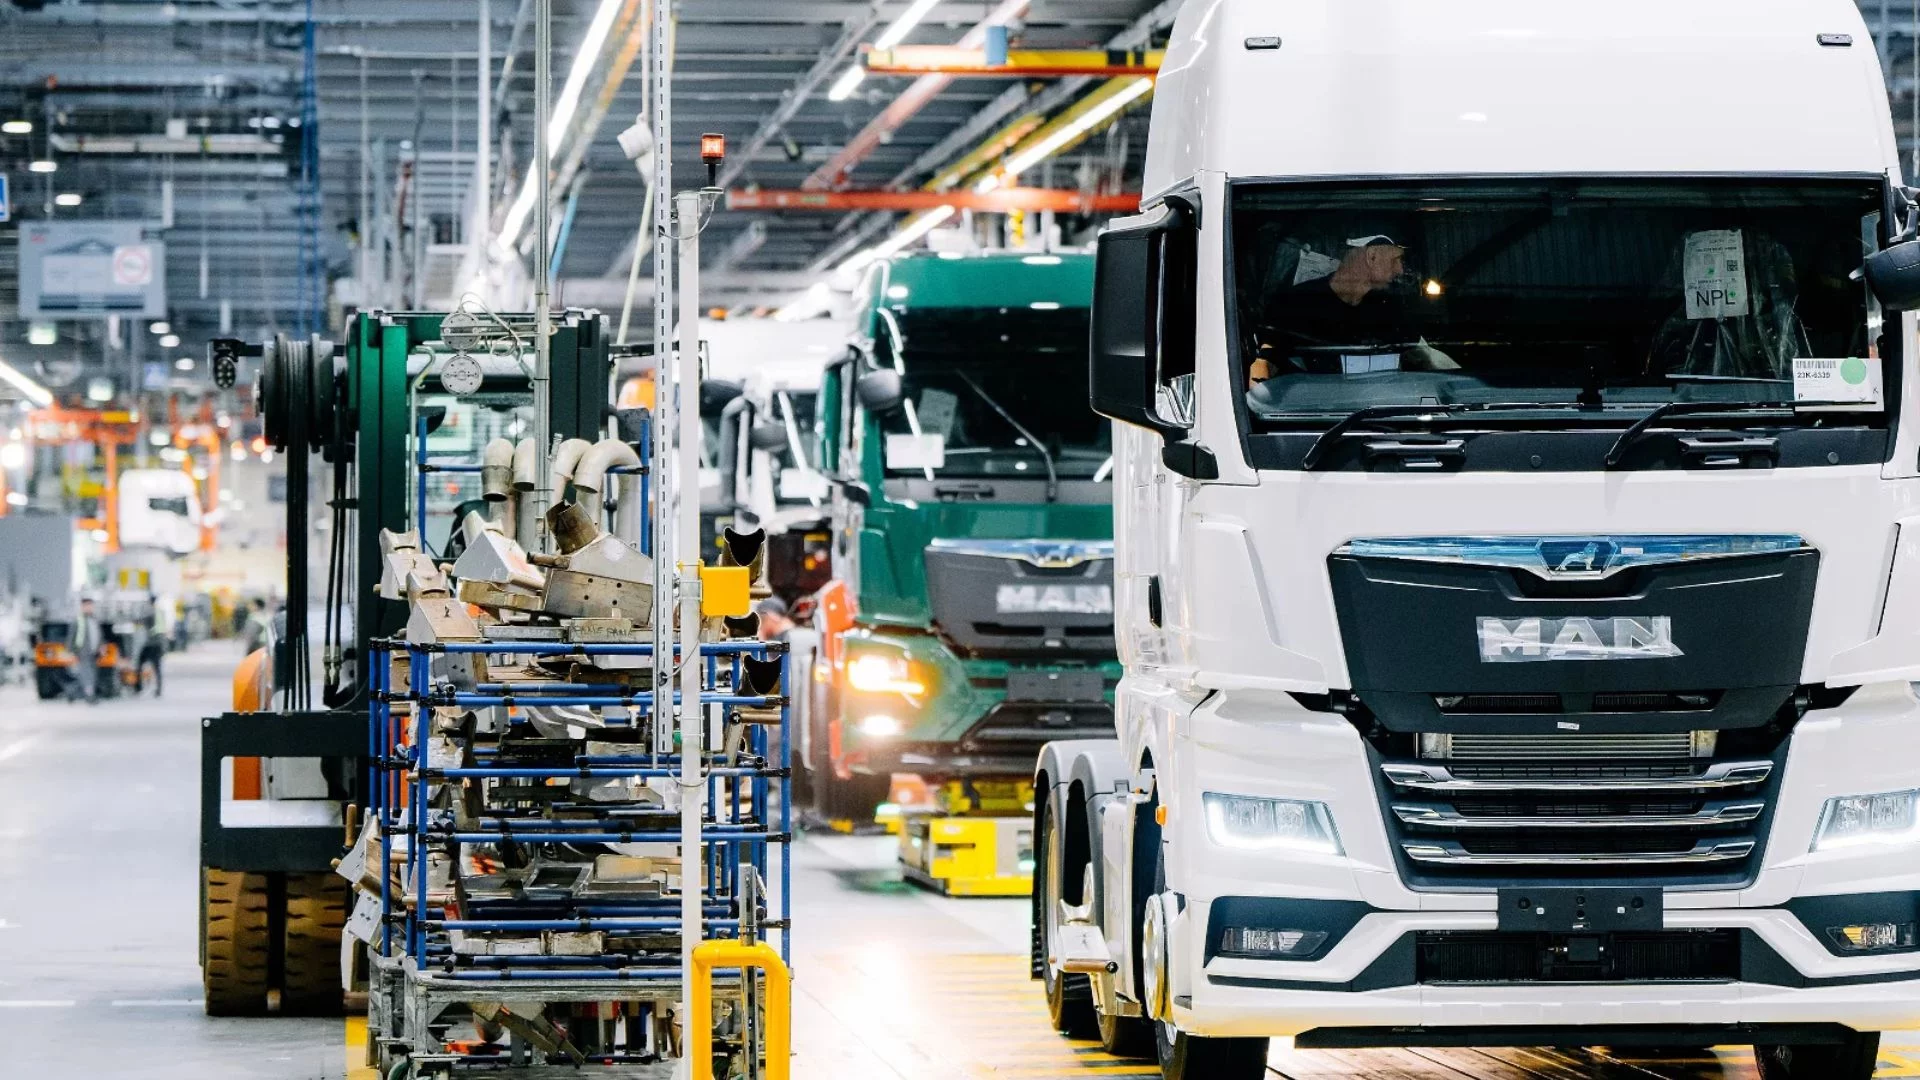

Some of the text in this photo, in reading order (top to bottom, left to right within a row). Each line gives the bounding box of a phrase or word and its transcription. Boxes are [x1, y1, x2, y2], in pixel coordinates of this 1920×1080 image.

[1696, 289, 1735, 307] NPL
[997, 585, 1112, 613] MAN
[1482, 618, 1672, 656] MAN
